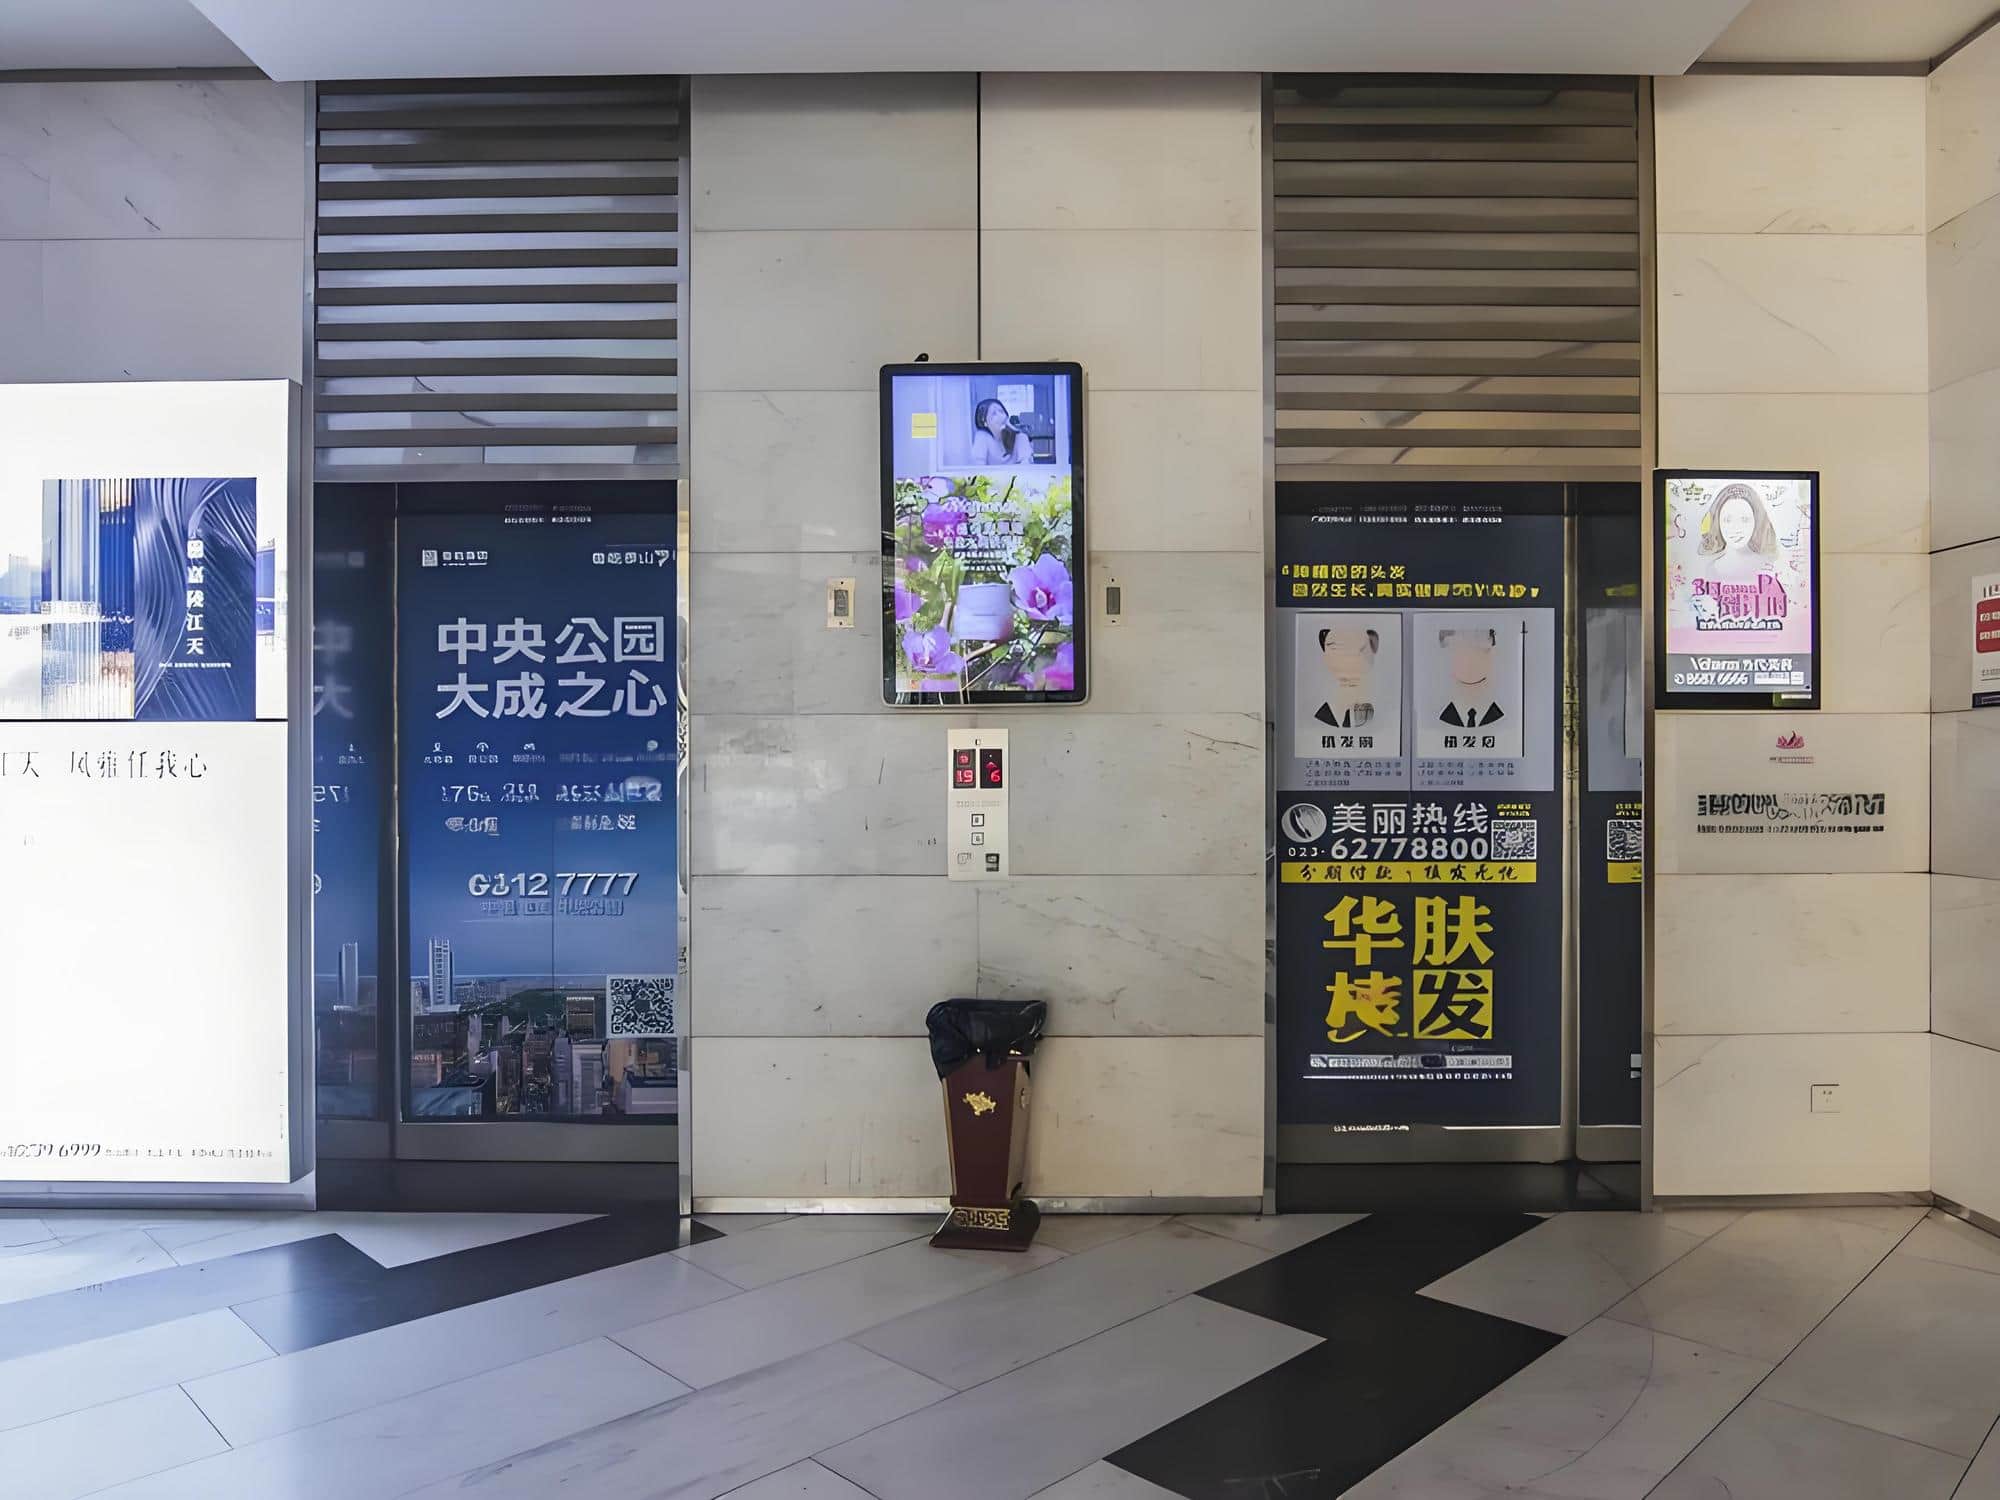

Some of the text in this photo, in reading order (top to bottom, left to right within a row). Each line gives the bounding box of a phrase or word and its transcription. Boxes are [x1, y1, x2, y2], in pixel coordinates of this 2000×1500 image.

[438, 616, 664, 664] 中央公园
[435, 669, 668, 719] 大成之心
[956, 769, 1001, 783] 19 6
[1331, 802, 1489, 834] 美丽热线
[1331, 838, 1489, 860] 62778800
[556, 872, 639, 896] 7777
[1323, 895, 1495, 966] 华肤
